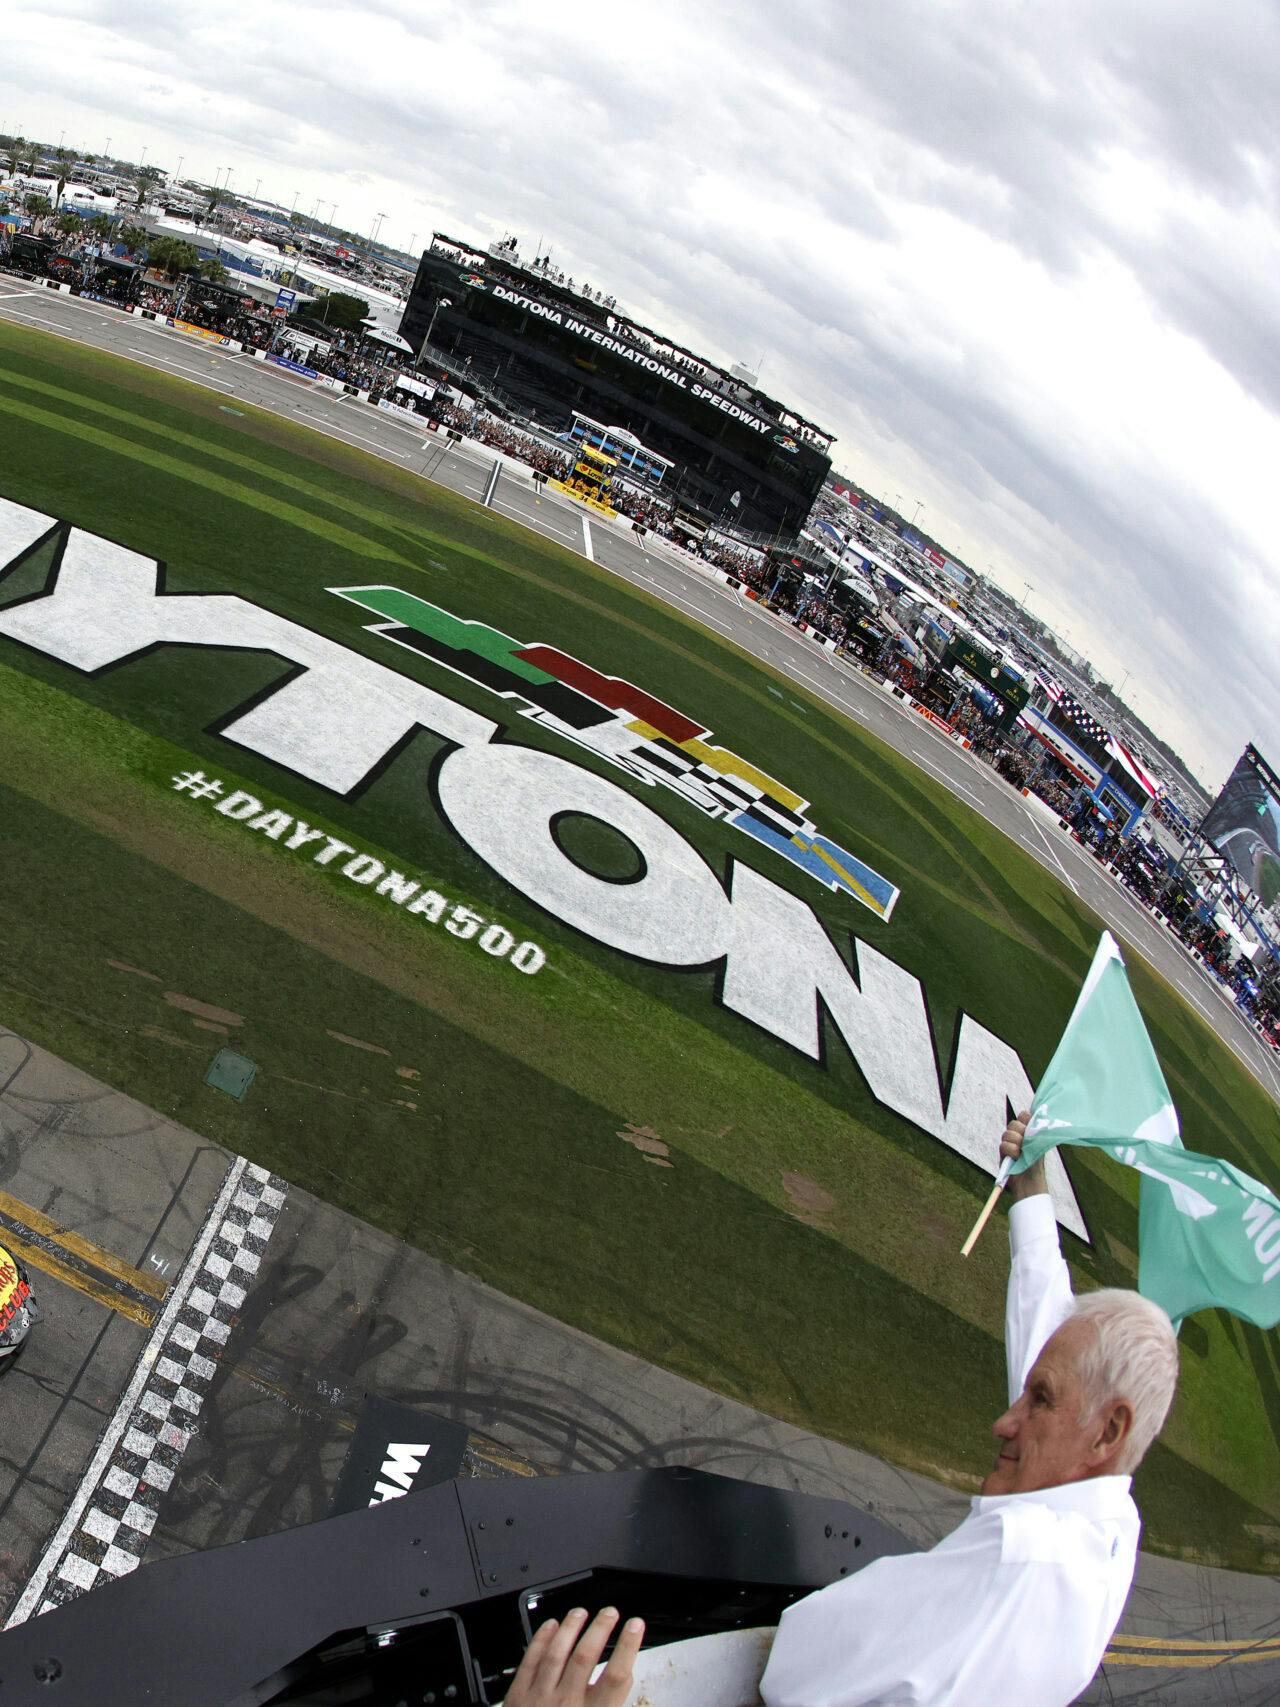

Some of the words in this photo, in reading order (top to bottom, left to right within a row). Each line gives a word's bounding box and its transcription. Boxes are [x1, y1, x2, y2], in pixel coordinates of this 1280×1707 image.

[492, 285, 562, 325] DAYTONA
[565, 318, 687, 389] INTERNATIONAL
[690, 383, 772, 435] SPEEDWAY
[171, 770, 547, 976] #DAYTONA500
[1114, 788, 1136, 811] CHEVROLET
